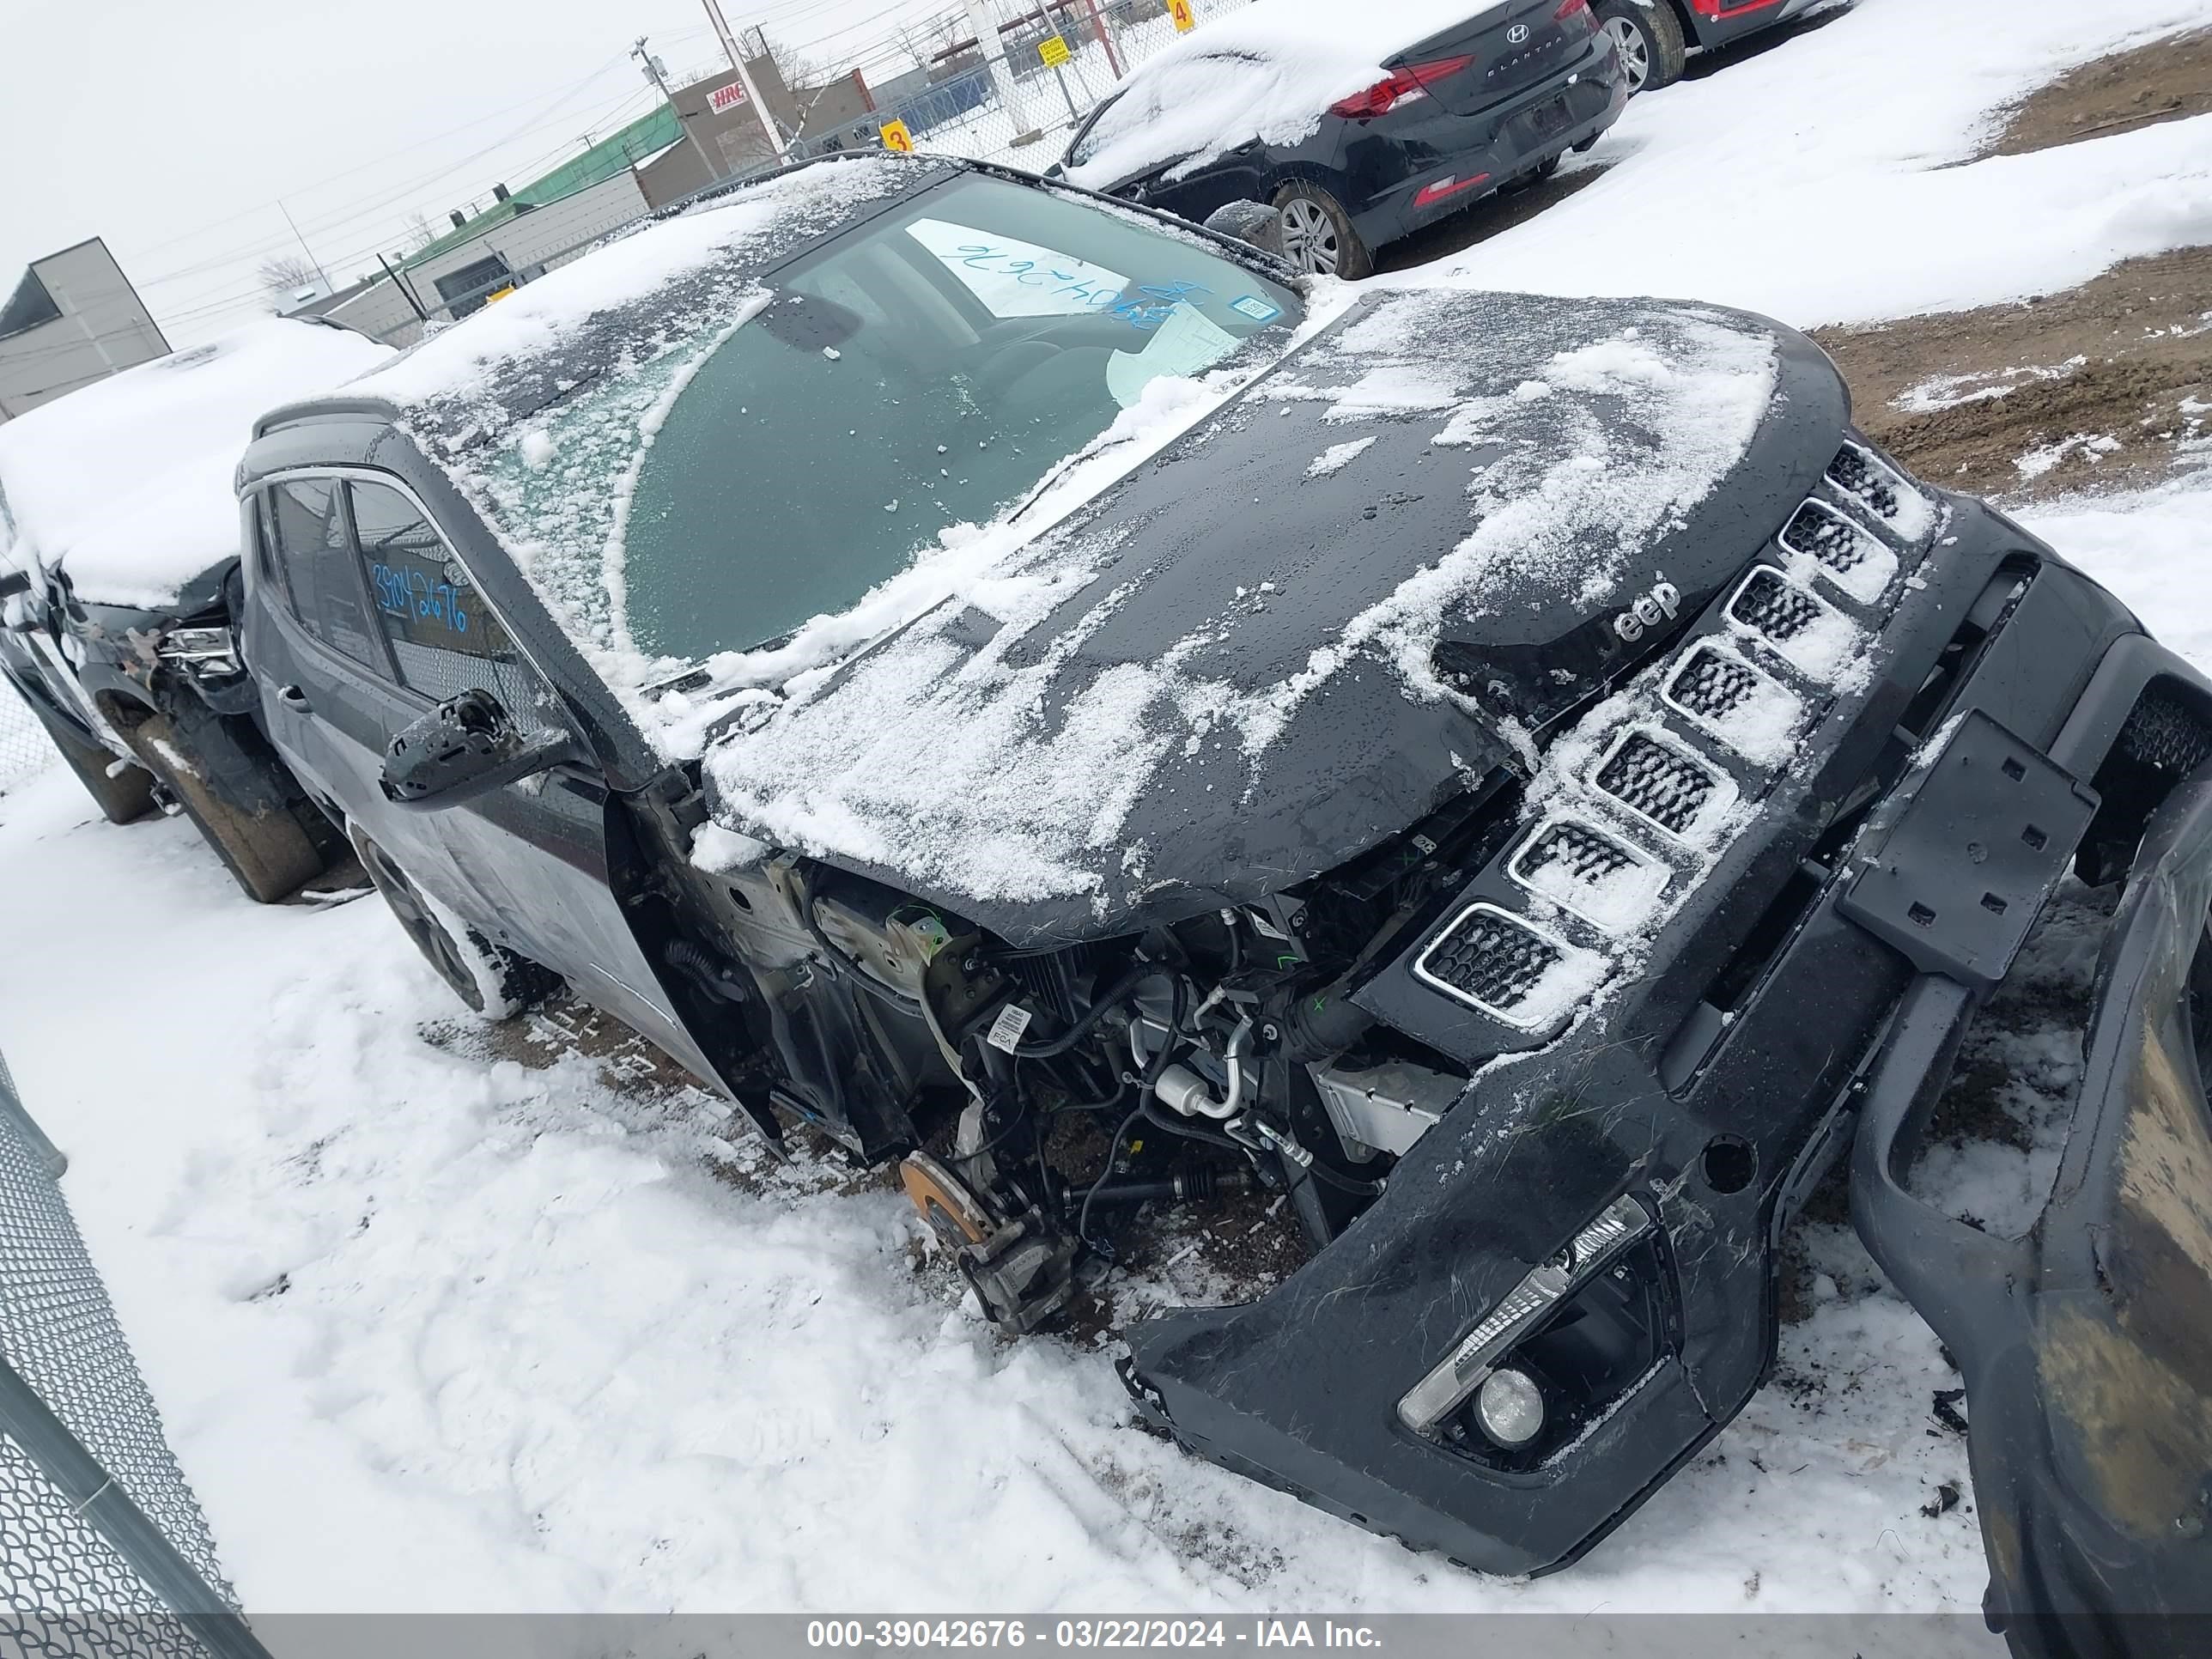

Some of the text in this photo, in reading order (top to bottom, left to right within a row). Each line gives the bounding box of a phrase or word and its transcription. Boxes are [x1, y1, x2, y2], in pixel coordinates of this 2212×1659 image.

[1176, 2, 1187, 22] 4
[1488, 36, 1561, 76] ELANTRA
[890, 131, 908, 151] 3
[373, 564, 467, 632] 39042676
[1613, 582, 1680, 642] eep
[994, 1032, 1011, 1045] FCA
